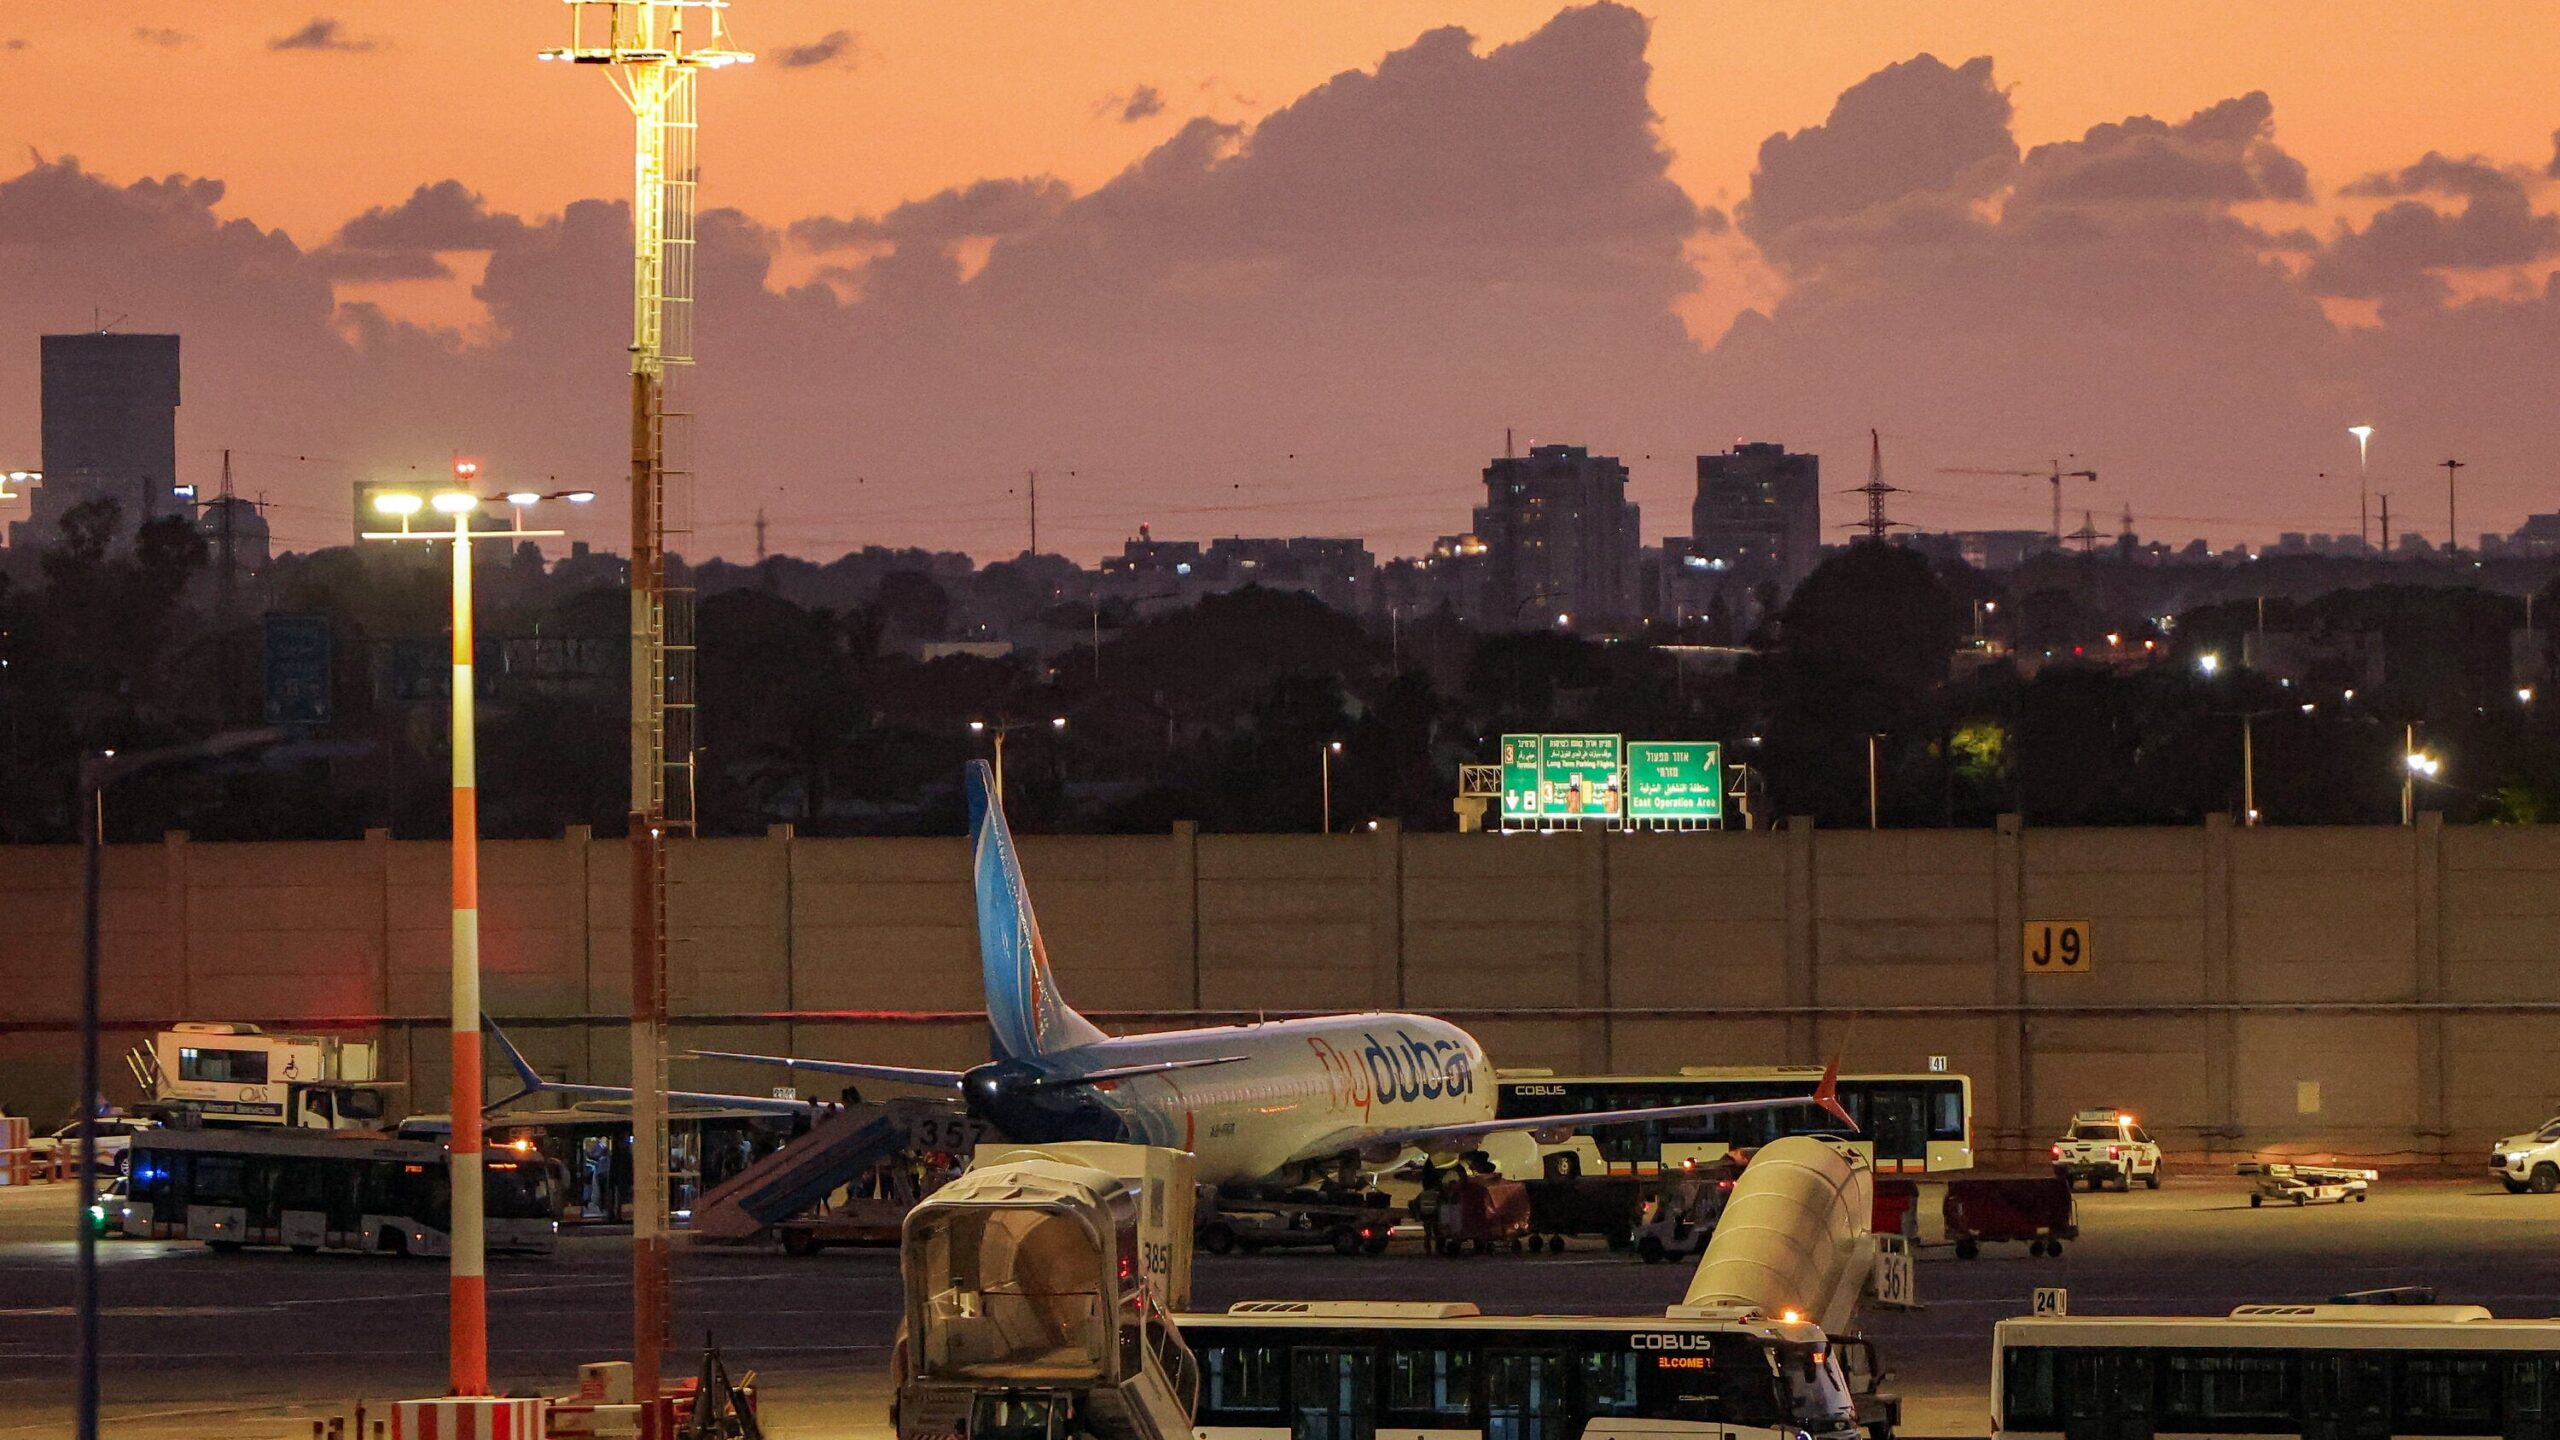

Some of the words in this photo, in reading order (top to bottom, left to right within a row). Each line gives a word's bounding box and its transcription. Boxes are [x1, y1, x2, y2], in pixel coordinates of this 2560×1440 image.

[1506, 745, 1513, 762] 3
[1672, 752, 1689, 762] אזור
[1546, 760, 1561, 769] Long
[1562, 760, 1575, 768] Term
[1576, 760, 1596, 769] Parking
[1657, 767, 1679, 778] מזרחי
[1633, 797, 1652, 808] East
[1654, 797, 1694, 810] Operation
[1696, 797, 1716, 808] Area
[1933, 1057, 1945, 1071] 41
[1307, 1030, 1473, 1123] flydubai
[1515, 1085, 1567, 1096] COBUS
[919, 1119, 988, 1148] 357
[1144, 1242, 1167, 1274] 385
[1884, 1257, 1908, 1300] 361
[2037, 1292, 2056, 1312] 24
[1630, 1333, 1711, 1351] COBUS
